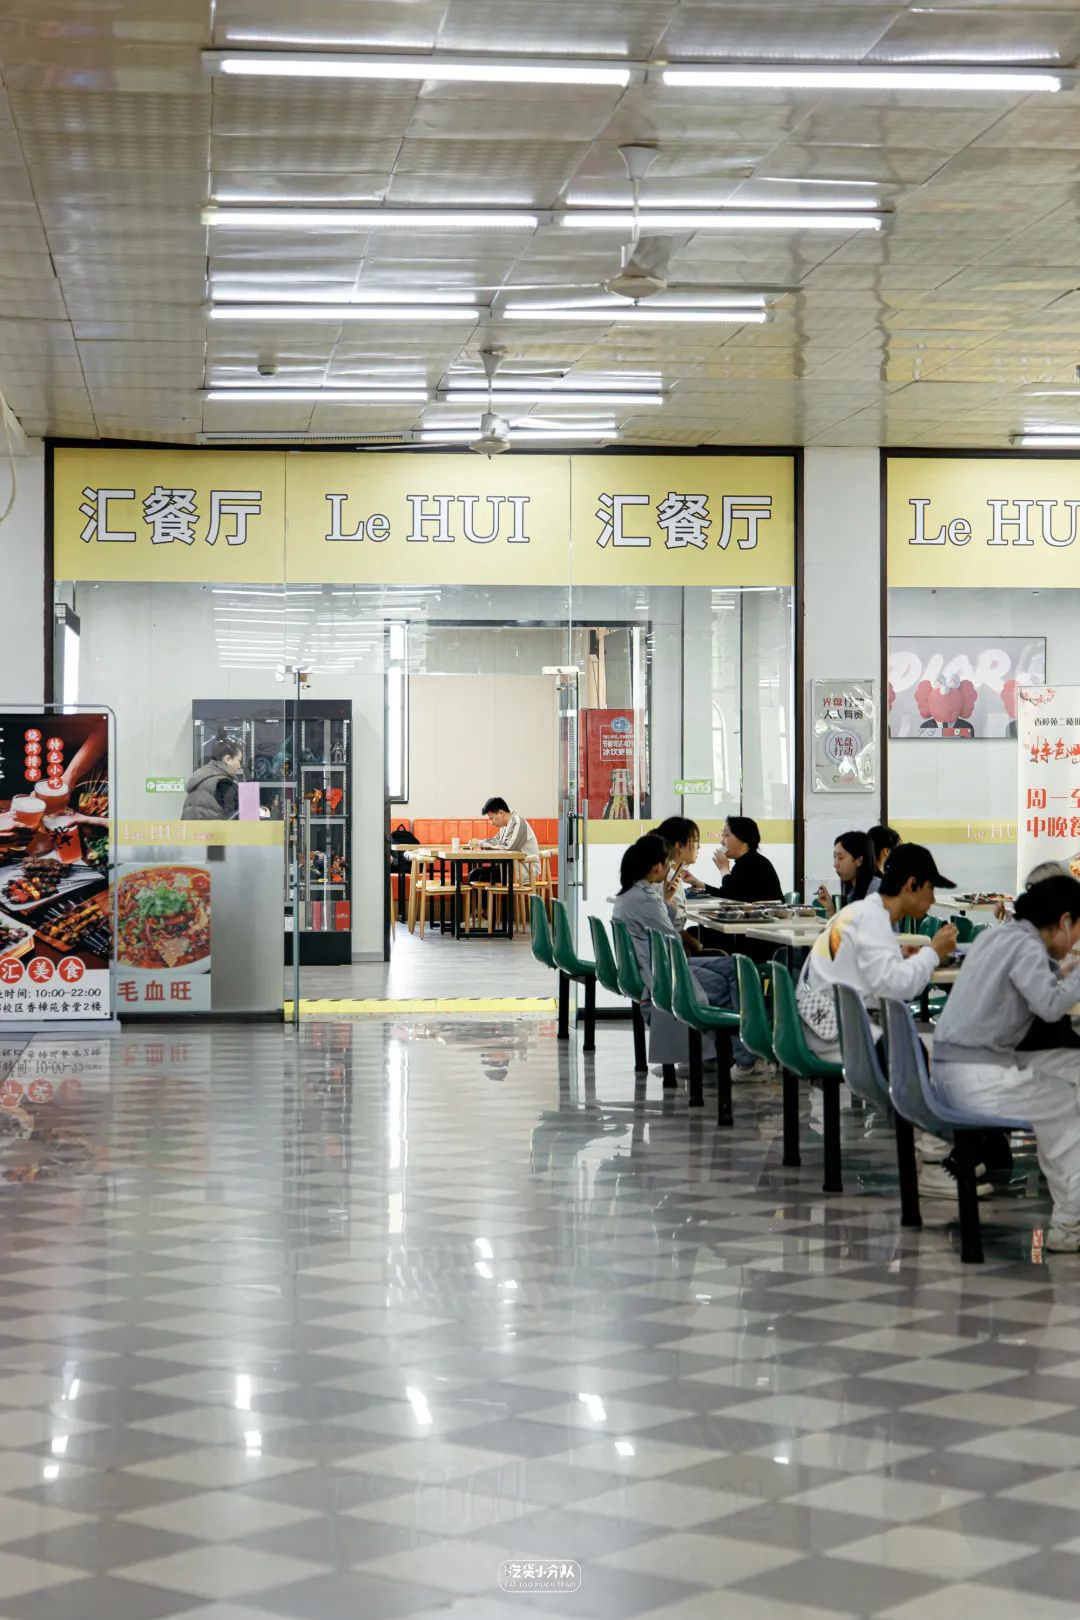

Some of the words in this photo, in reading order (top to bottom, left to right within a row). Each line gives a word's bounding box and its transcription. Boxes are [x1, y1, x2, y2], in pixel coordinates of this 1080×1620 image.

[79, 486, 262, 546] 汇餐厅
[325, 493, 390, 542] Le
[406, 494, 530, 543] HUI
[595, 492, 772, 550] 汇餐厅
[908, 498, 972, 546] Le
[834, 737, 853, 747] 光盘
[834, 747, 853, 757] 行动
[48, 738, 62, 788] 特色小吃
[1, 960, 82, 980] 汇美食
[0, 989, 31, 999] 时间:
[117, 980, 192, 1002] 毛血旺
[0, 1001, 102, 1013] 校区香樟苑食堂2楼
